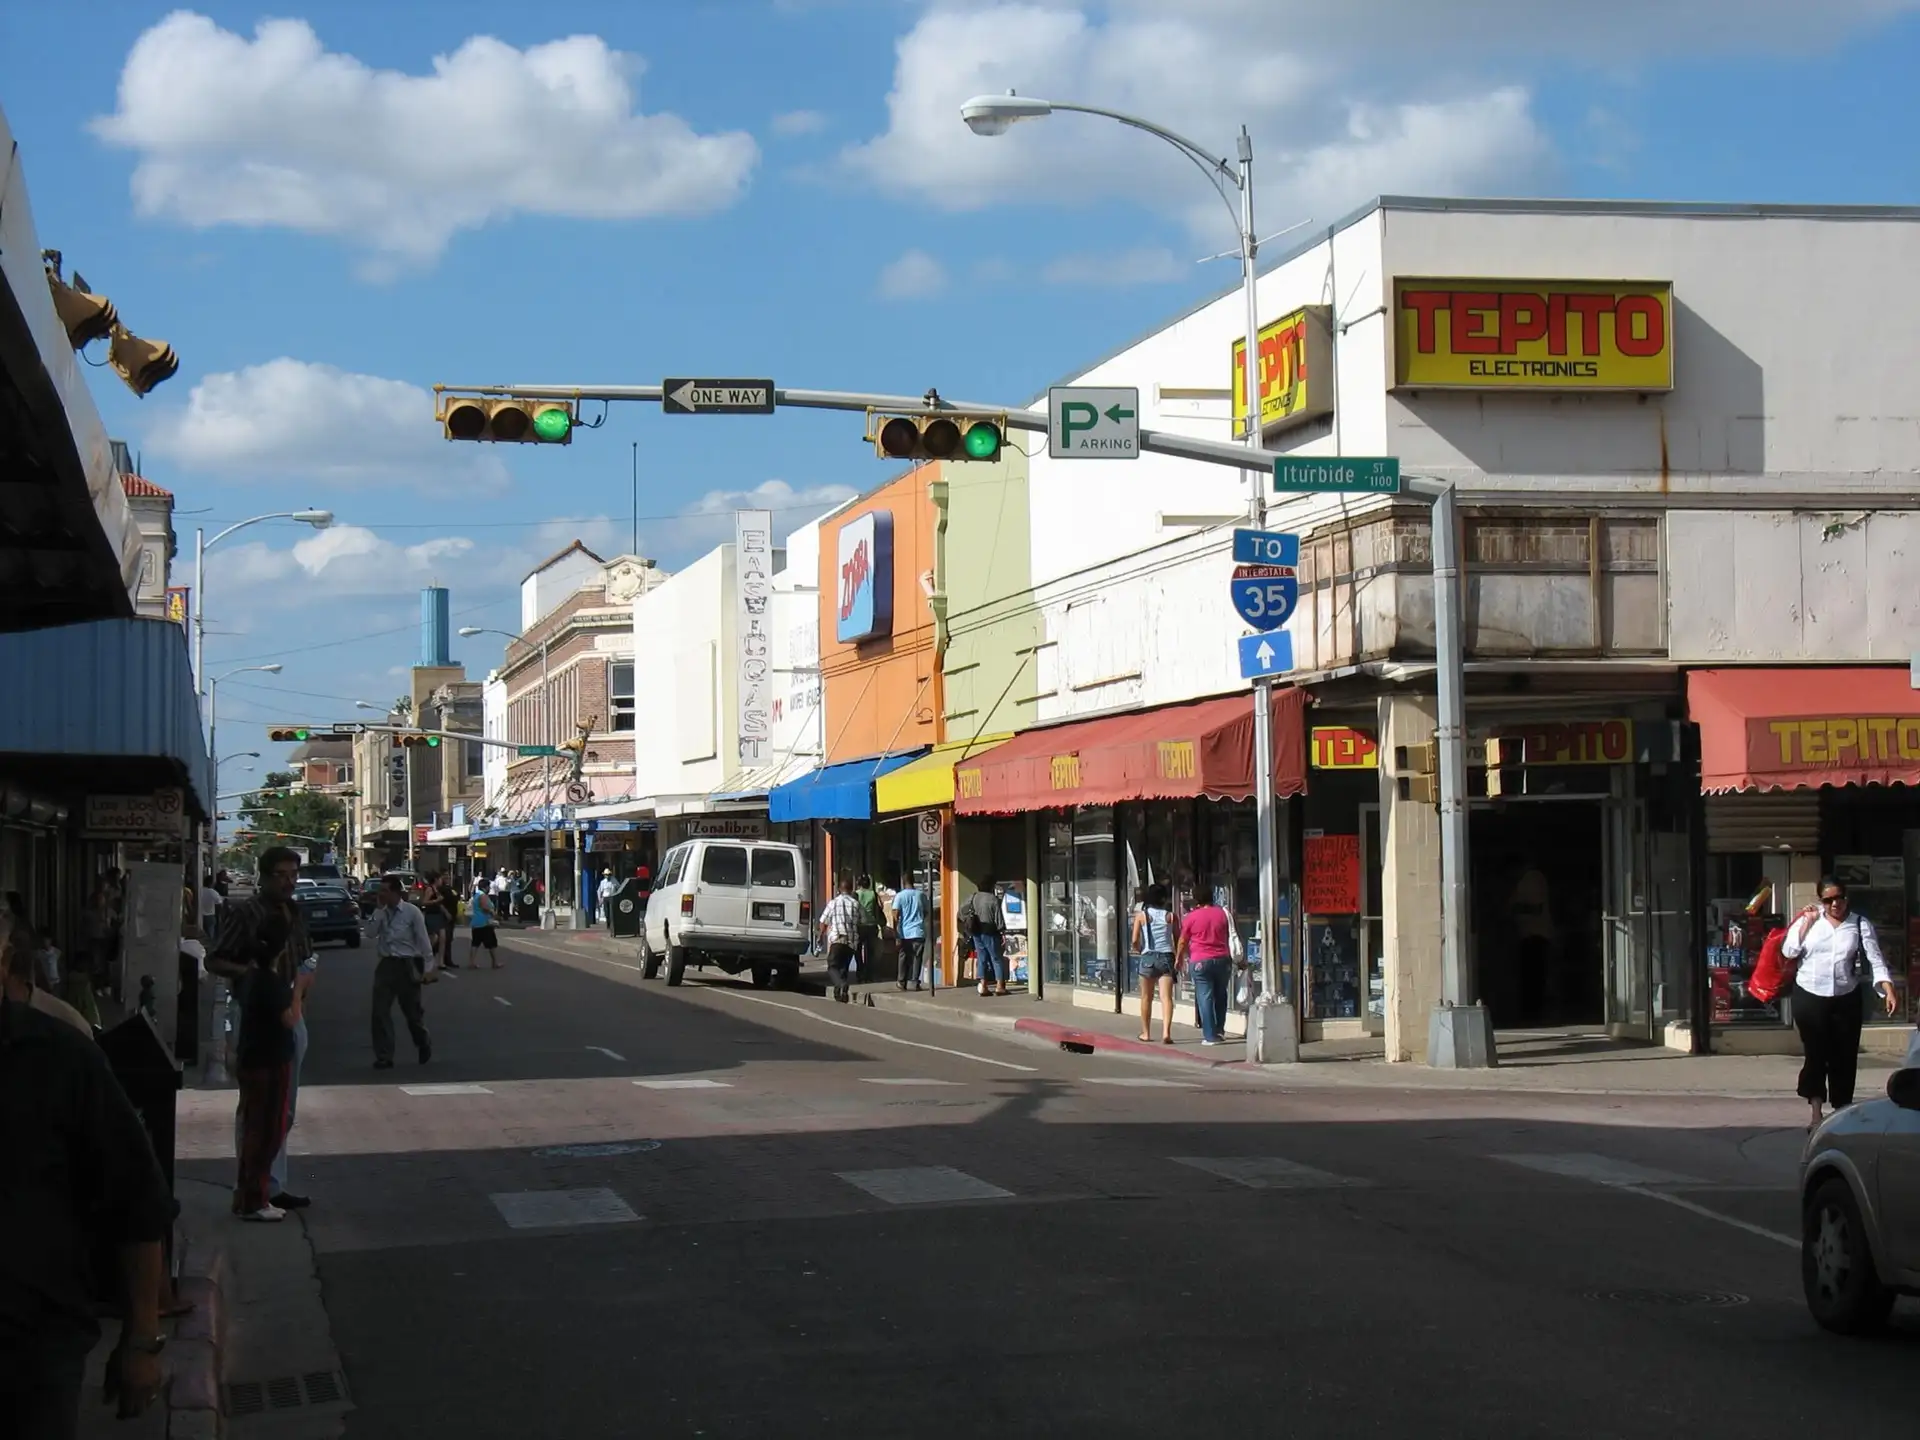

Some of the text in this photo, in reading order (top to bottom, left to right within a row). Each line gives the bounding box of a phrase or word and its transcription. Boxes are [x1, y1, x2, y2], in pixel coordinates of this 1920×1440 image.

[1402, 290, 1664, 357] TEPITO
[1470, 360, 1597, 377] ELECTRONICS
[691, 389, 760, 403] ONE WAY
[1283, 462, 1385, 483] Iturbide ST
[1370, 475, 1392, 487] 1100
[1251, 537, 1282, 559] TO
[1239, 566, 1287, 578] INTERSTATE
[1245, 585, 1287, 617] 35
[1158, 741, 1195, 779] TEPITO
[1052, 753, 1080, 790] TEPITO
[692, 821, 760, 834] Zonalibre
